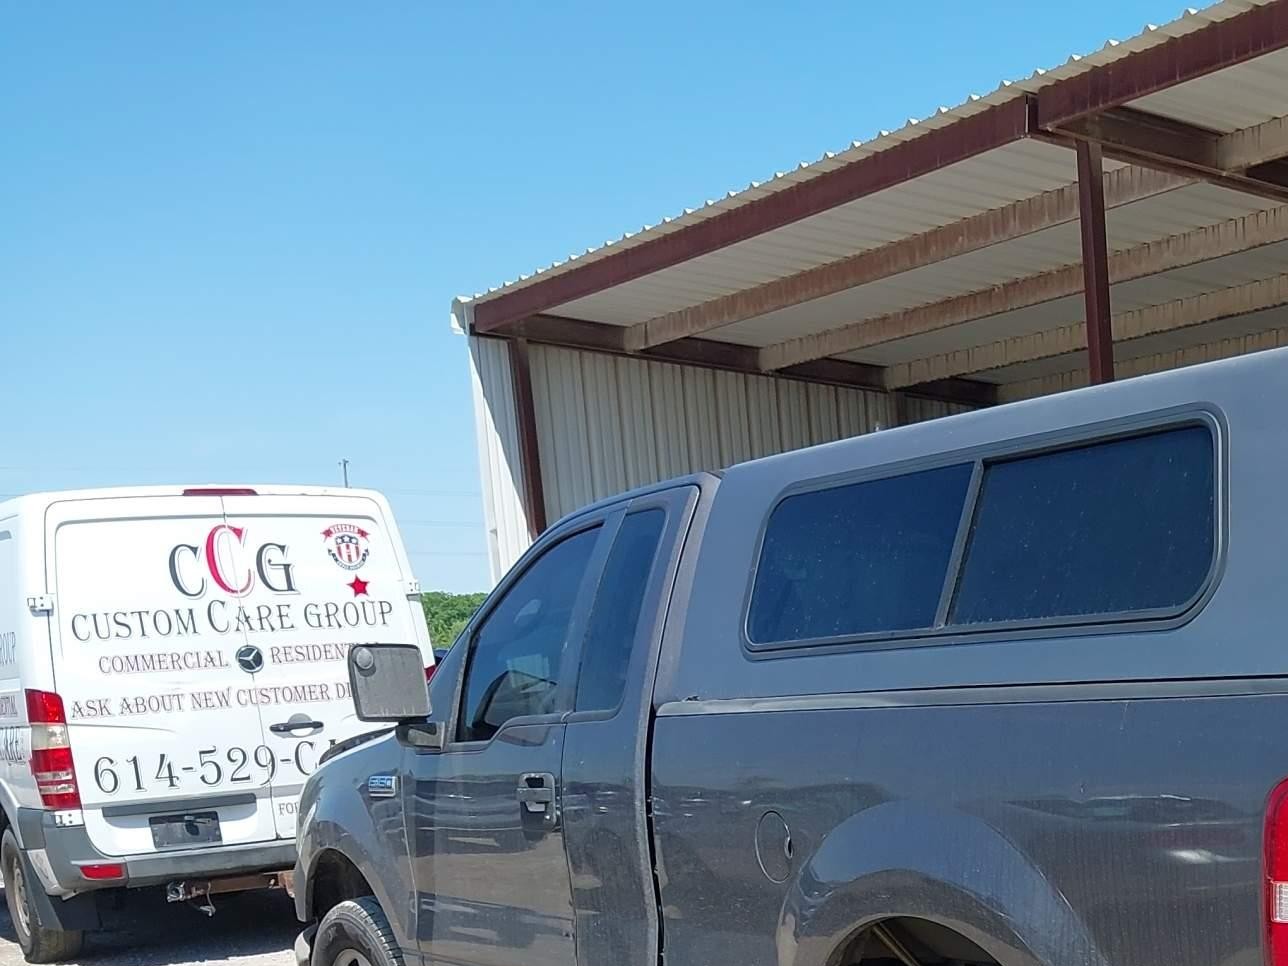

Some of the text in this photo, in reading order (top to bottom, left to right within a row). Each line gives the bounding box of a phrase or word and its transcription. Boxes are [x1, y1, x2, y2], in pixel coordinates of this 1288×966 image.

[71, 599, 393, 641] CUSTOM CARE GROUP
[99, 651, 229, 673] COMMERCIAL
[72, 698, 112, 718] ASK
[120, 693, 184, 715] ABOUT
[190, 686, 231, 709] NEW
[236, 683, 330, 706] CUSTOMER
